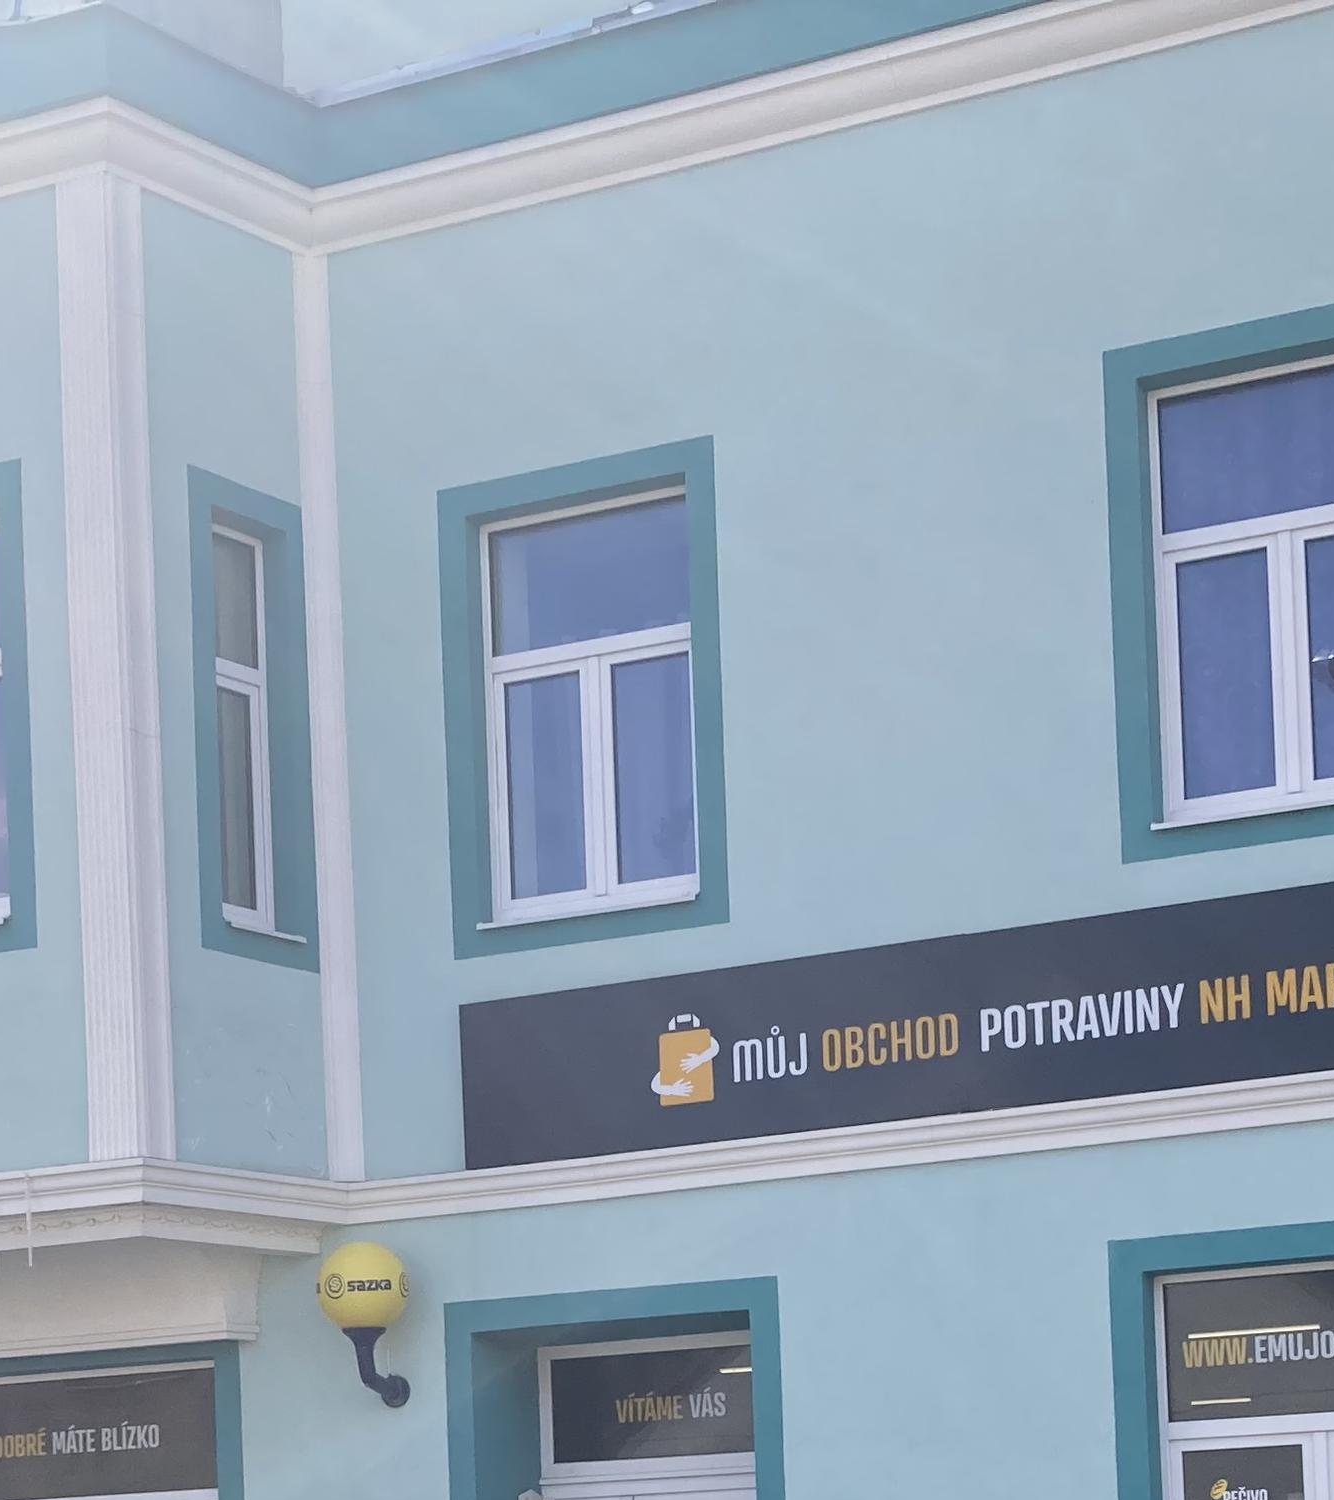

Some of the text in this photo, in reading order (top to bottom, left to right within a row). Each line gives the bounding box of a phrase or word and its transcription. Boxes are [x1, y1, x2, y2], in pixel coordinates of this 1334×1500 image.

[822, 1013, 960, 1072] OBCHOD
[979, 983, 1185, 1052] POTRAVINY
[1198, 974, 1251, 1025] NH
[616, 1386, 727, 1423] VÍTÁME VÁS
[52, 1425, 96, 1455] MÁTE
[101, 1421, 160, 1451] BLÍZKO
